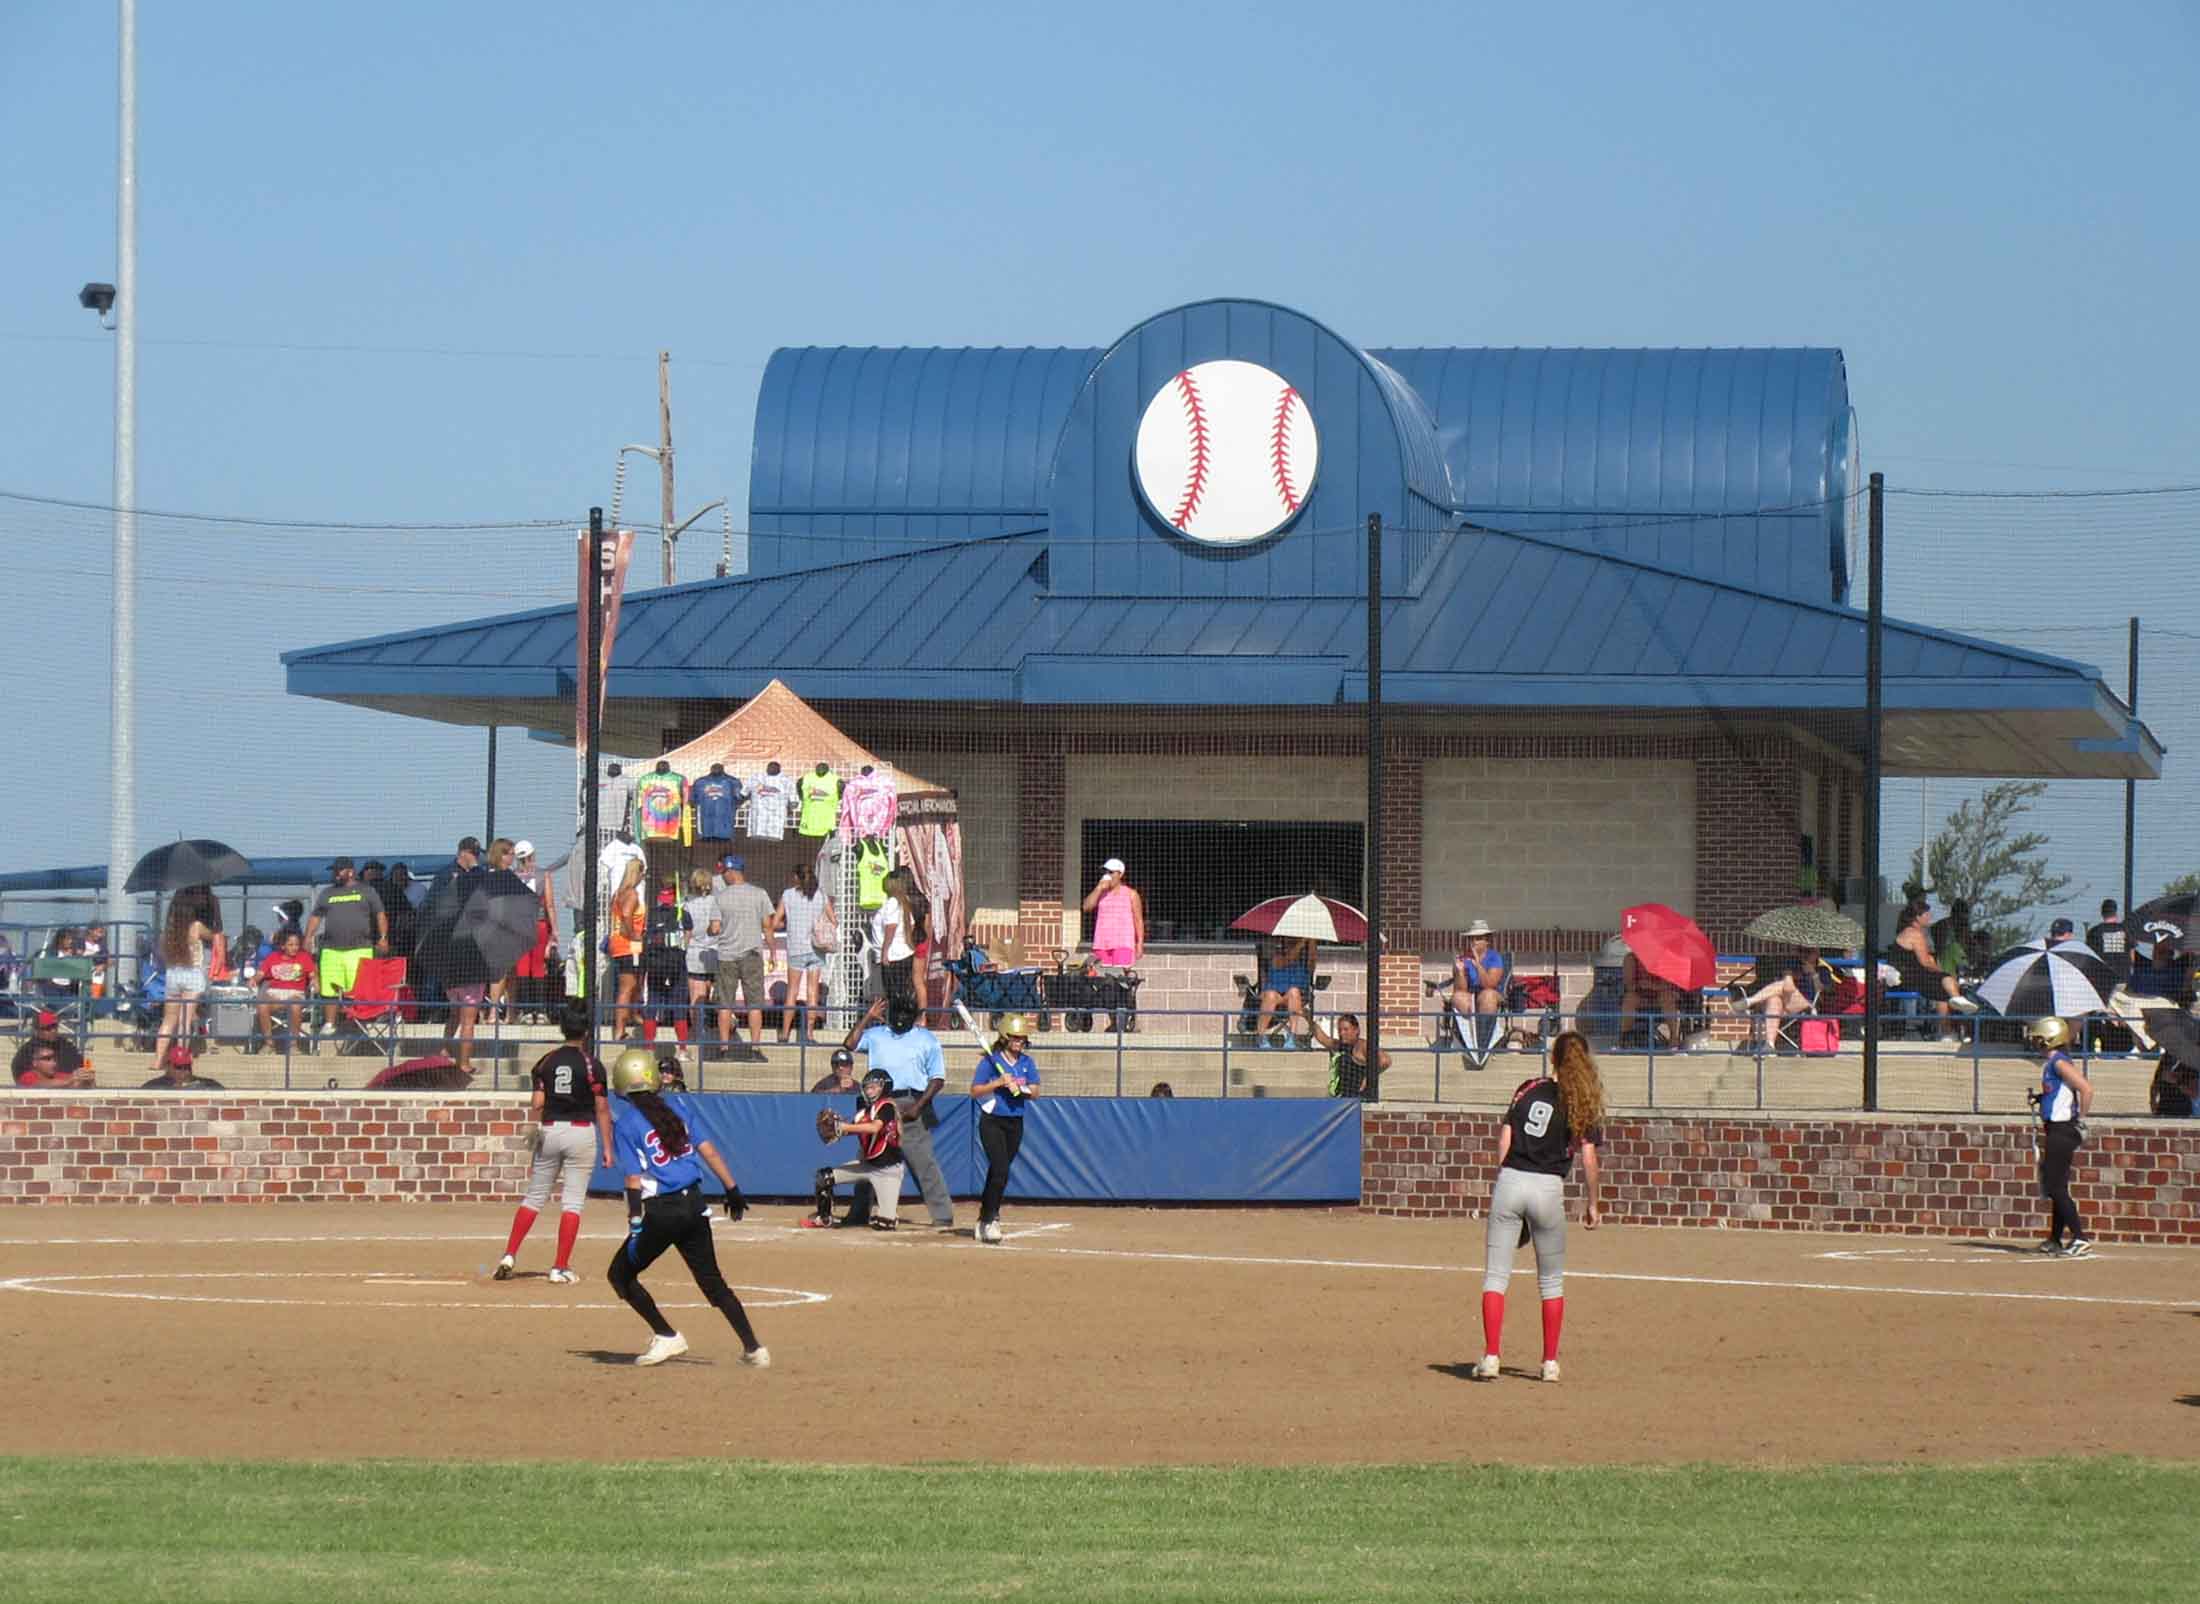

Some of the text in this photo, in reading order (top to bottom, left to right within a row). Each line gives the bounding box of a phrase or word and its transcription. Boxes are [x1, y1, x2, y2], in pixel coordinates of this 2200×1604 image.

[554, 1065, 573, 1094] 2
[1523, 1100, 1554, 1138] 9
[644, 1128, 694, 1168] 3
